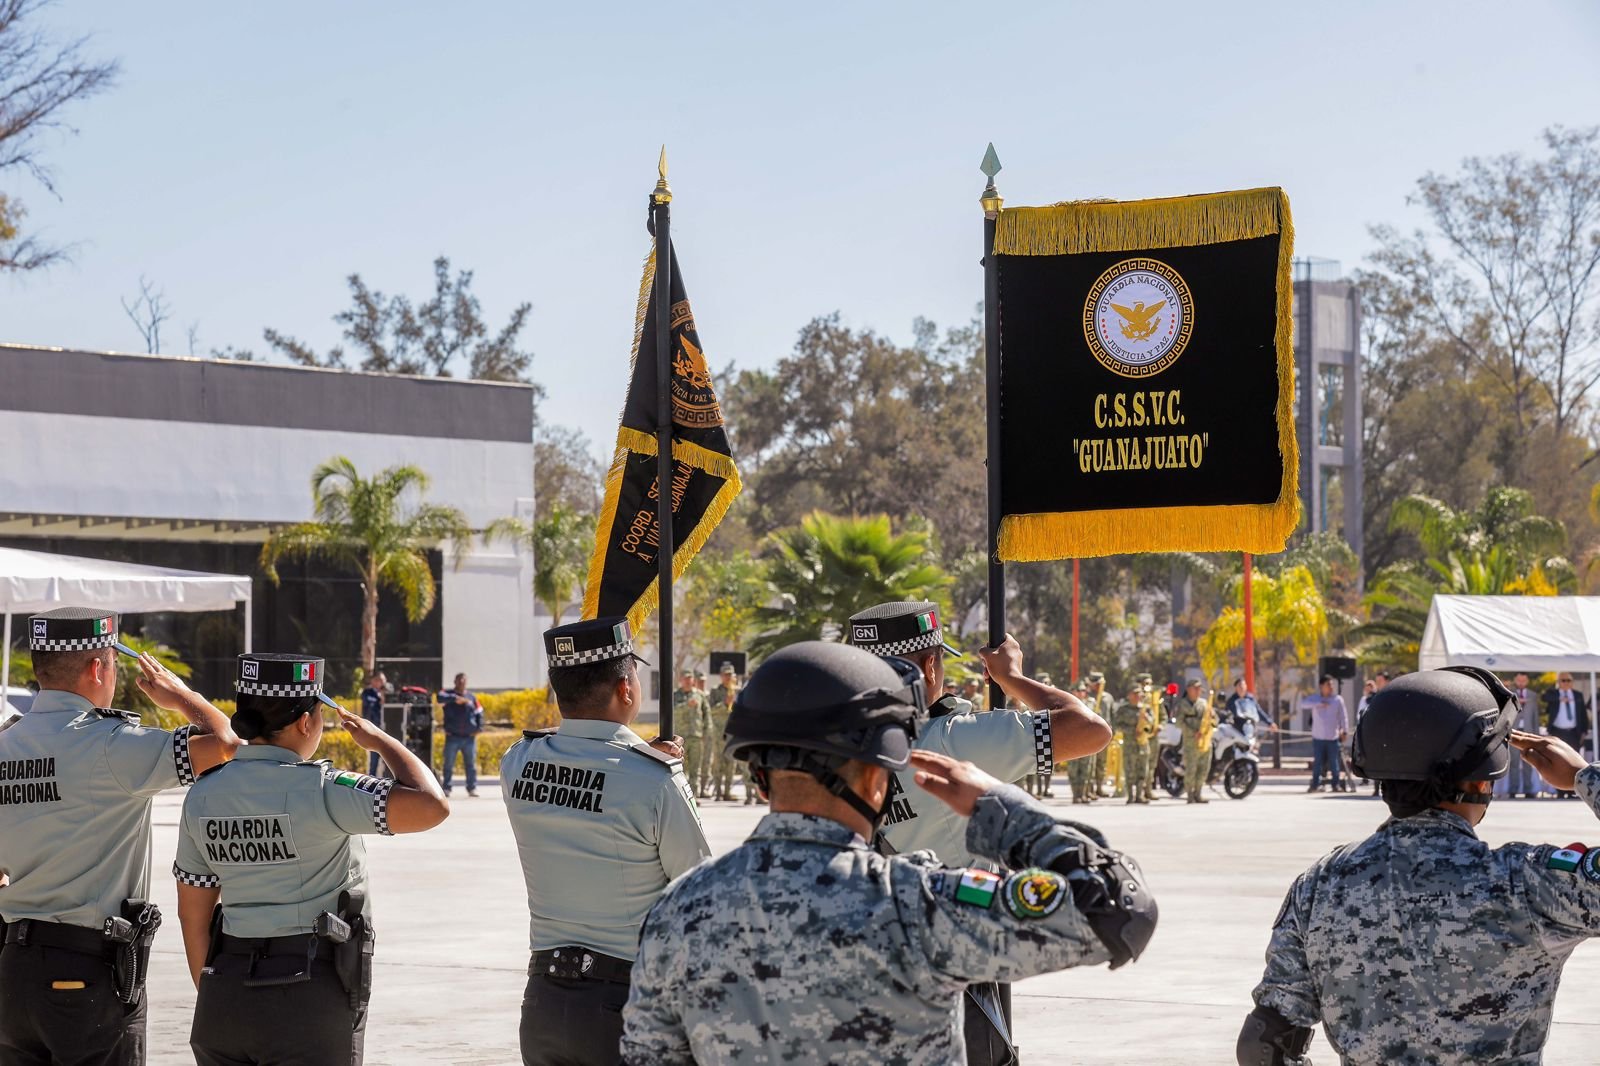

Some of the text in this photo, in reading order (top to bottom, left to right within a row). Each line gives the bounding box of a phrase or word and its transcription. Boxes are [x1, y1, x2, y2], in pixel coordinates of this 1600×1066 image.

[1101, 276, 1175, 313] GUARDIA NACIONAL
[1107, 339, 1146, 360] JUSTICIA
[1155, 336, 1170, 352] PAZ
[1094, 389, 1185, 429] C.S.S.V.C.
[1073, 432, 1209, 473] "GUANAJUATO"
[622, 510, 655, 553] COORD.
[637, 551, 653, 563] A
[33, 622, 46, 635] GN
[855, 627, 875, 639] GN
[558, 642, 572, 653] GN
[244, 664, 257, 675] GN
[0, 757, 56, 781] GUARDIA
[521, 760, 606, 791] GUARDIA
[511, 779, 604, 813] NACIONAL
[206, 818, 284, 841] GUARDIA
[205, 841, 296, 863] NACIONAL
